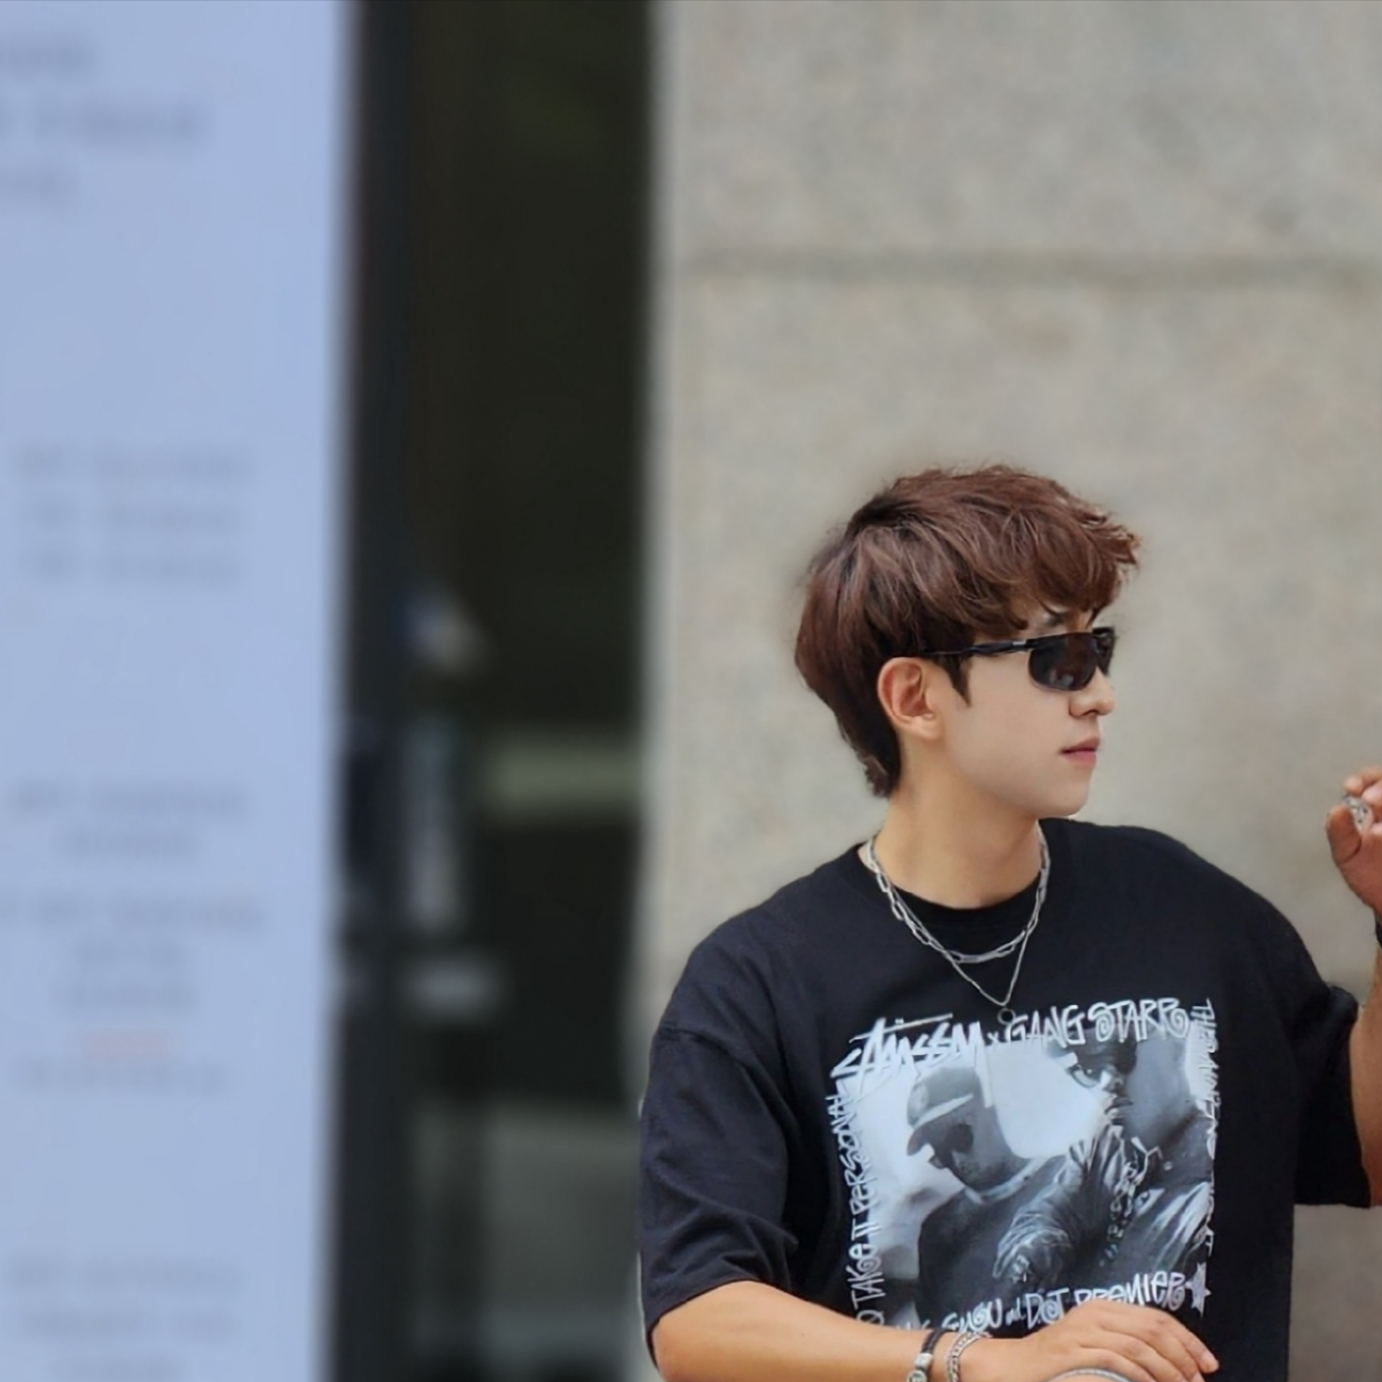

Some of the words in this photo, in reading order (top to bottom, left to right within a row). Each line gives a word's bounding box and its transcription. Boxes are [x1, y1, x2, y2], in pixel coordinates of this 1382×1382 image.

[1005, 1005, 1086, 1048] GANG
[1088, 998, 1190, 1043] STARR
[851, 1219, 881, 1240] IT
